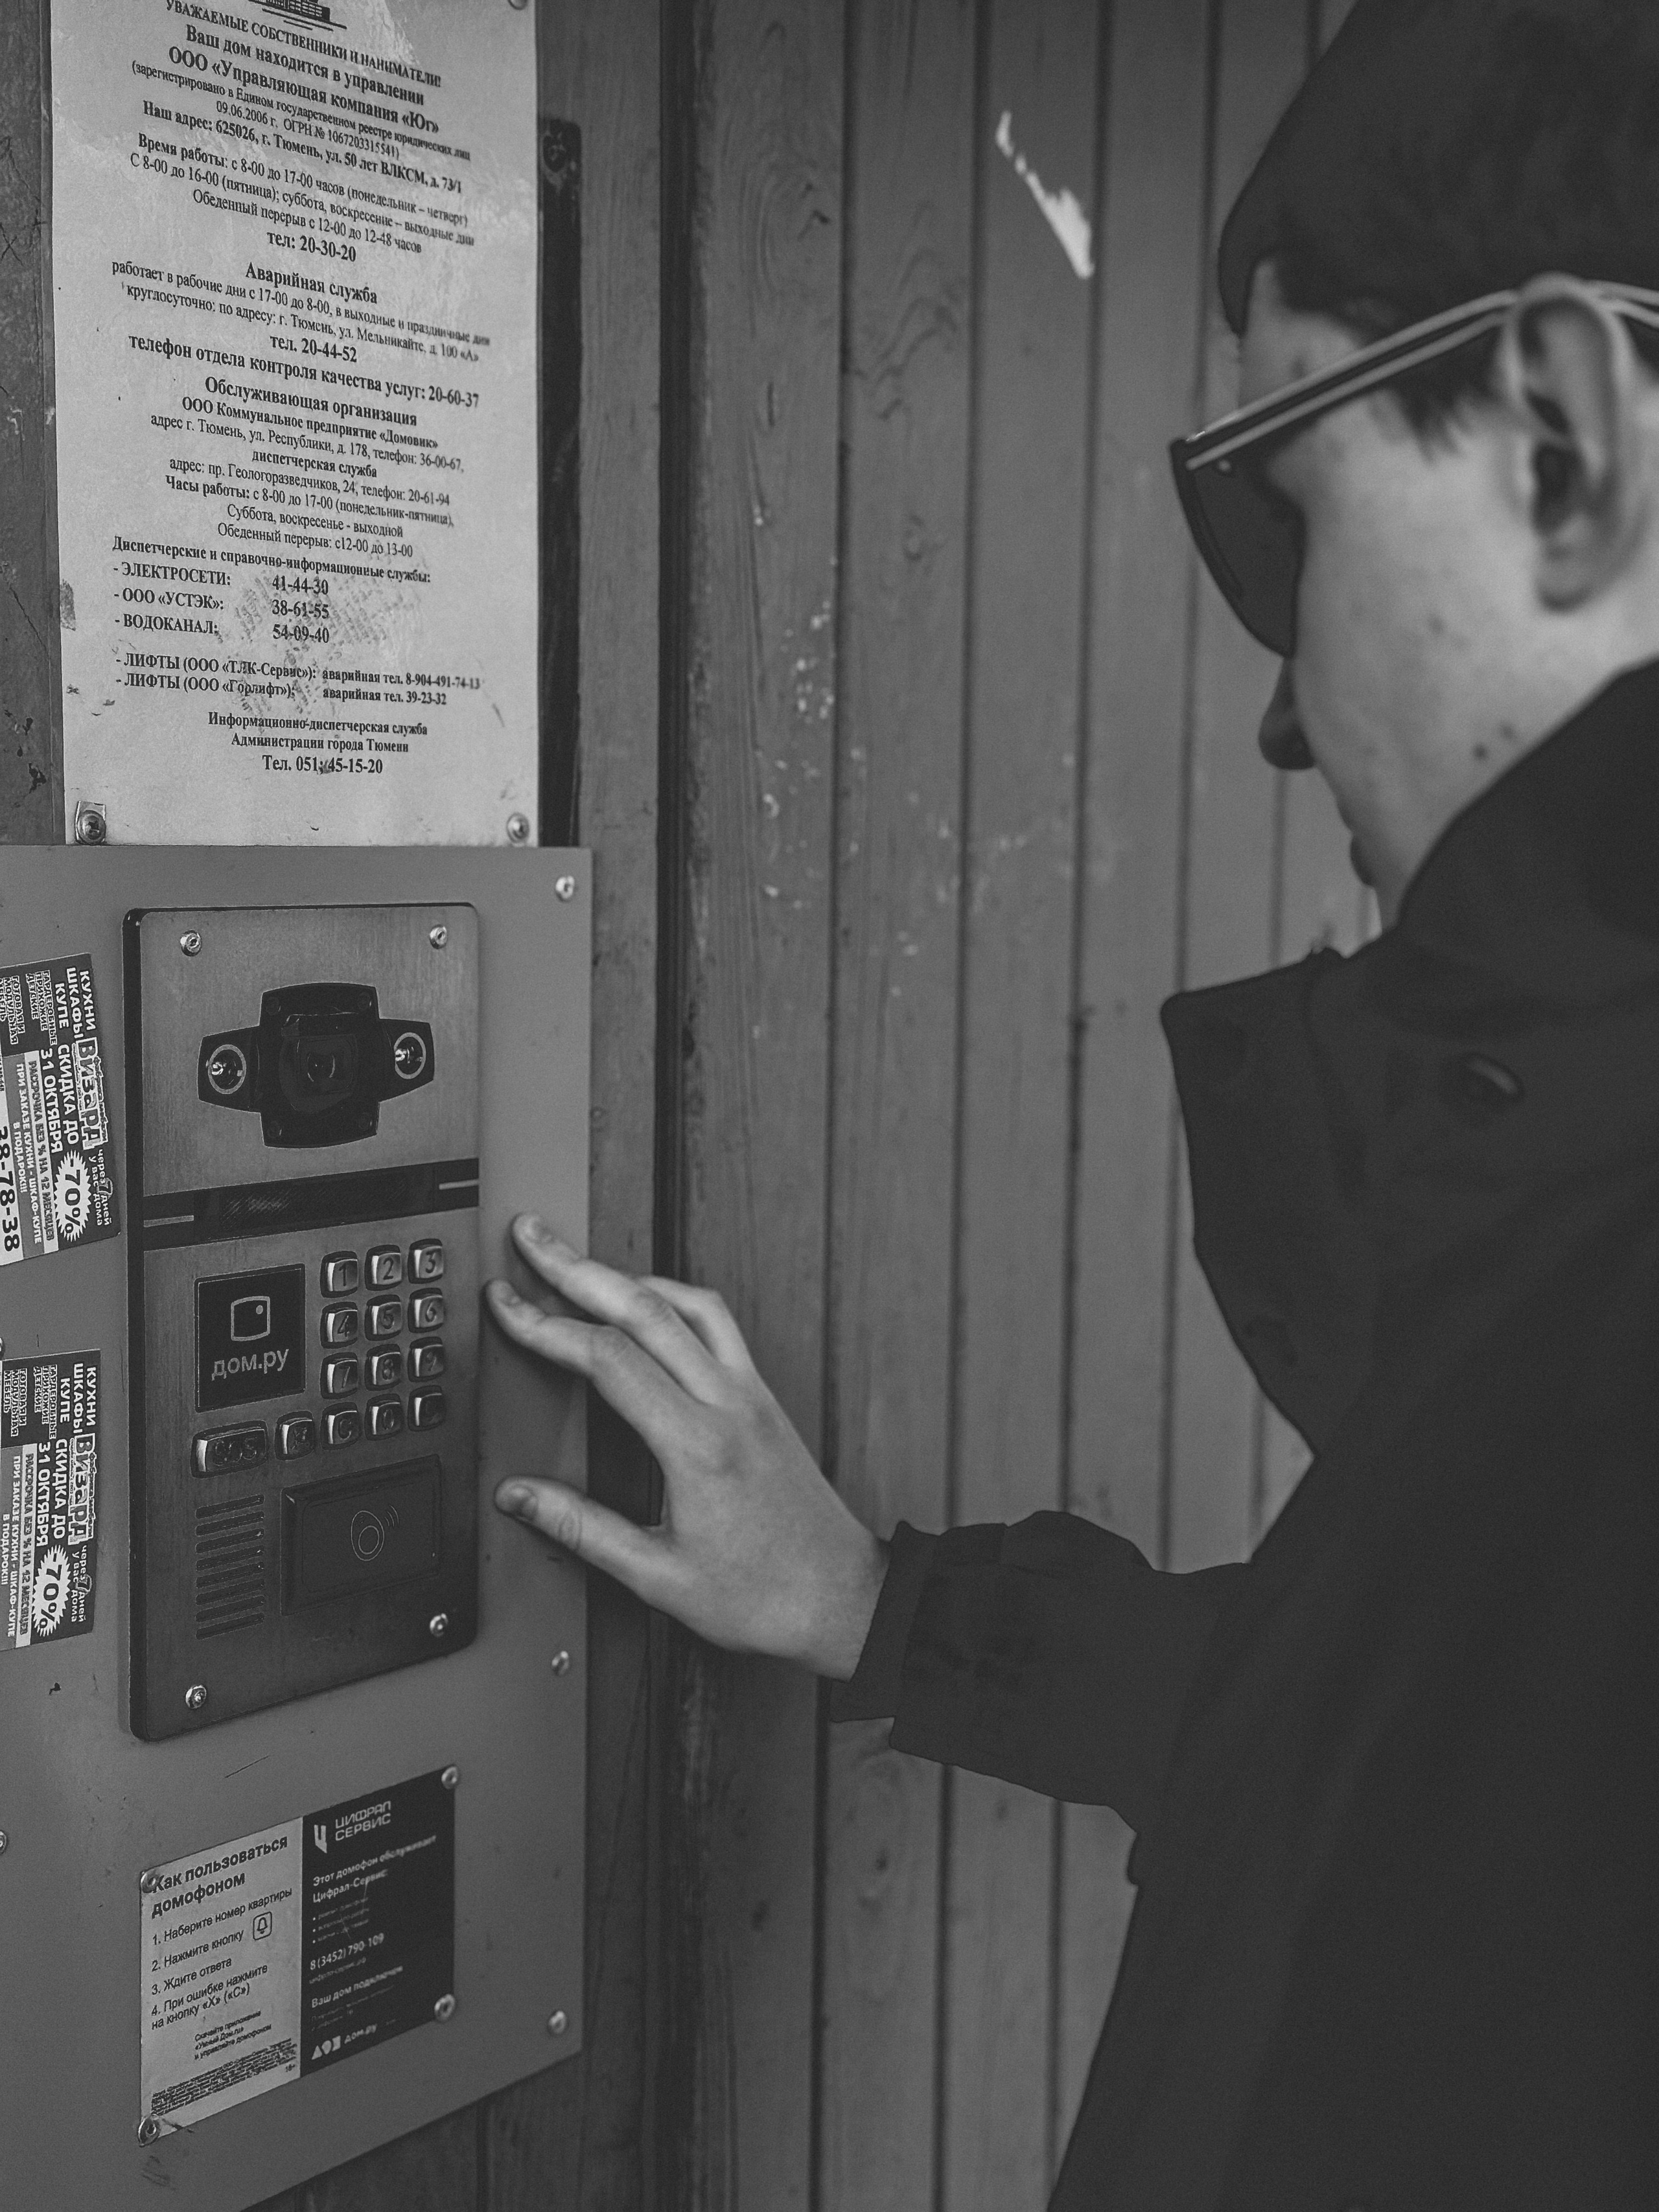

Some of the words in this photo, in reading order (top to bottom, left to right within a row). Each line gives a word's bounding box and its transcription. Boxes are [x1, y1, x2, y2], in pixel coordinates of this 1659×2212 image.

[166, 0, 249, 33] УВАЖАЕМЫЕ
[251, 21, 347, 61] СОБСТВЕННИКИ
[185, 23, 220, 49] Ваш
[223, 39, 251, 58] дом
[255, 46, 329, 80] находится
[343, 72, 424, 106] управлении
[168, 45, 209, 72] ООО
[211, 59, 327, 104] «Управляющая
[331, 93, 399, 124] компания
[401, 110, 439, 134] «Юг»
[143, 99, 172, 121] Наш
[174, 111, 213, 132] адрес:
[215, 119, 259, 145] 625026,
[272, 133, 323, 161] Тюмень,
[343, 152, 358, 168] 50
[358, 158, 378, 173] лет
[380, 159, 428, 187] ВЛКСМ,
[216, 100, 268, 125] 09.06.2006
[283, 118, 312, 137] ОГРН
[328, 129, 399, 161] 1067203315541)
[138, 132, 178, 156] Время
[180, 146, 228, 169] работы:
[240, 157, 265, 177] 8-00
[284, 169, 313, 189] 17-00
[315, 180, 345, 196] часов
[347, 185, 417, 214] (понедельник
[192, 189, 259, 216] Обеденный
[261, 206, 307, 228] перерыв
[319, 217, 346, 237] 12-00
[364, 227, 392, 247] 12-48
[393, 238, 423, 254] часов
[266, 231, 296, 250] тел:
[299, 235, 356, 262] 20-30-20
[245, 261, 325, 294] Аварийная
[329, 282, 378, 305] служба
[128, 335, 192, 359] телефон
[196, 348, 246, 368] отдела
[249, 357, 318, 381] контроля
[321, 369, 382, 392] качества
[385, 381, 426, 401] услуг:
[428, 385, 480, 408] 20-60-37
[269, 335, 297, 353] тел.
[301, 337, 358, 364] 20-44-52
[181, 396, 214, 414] ООО
[216, 401, 303, 429] Коммунальное
[306, 419, 377, 440] предприятие
[379, 428, 439, 449] «Домовик»
[205, 376, 329, 412] Обслуживающая
[332, 402, 417, 427] организация
[251, 450, 336, 472] диспетчерская
[338, 463, 377, 479] служба
[111, 535, 207, 560] Диспетчерские
[220, 551, 385, 584] справочно-информационные
[386, 569, 431, 583] службы:
[121, 561, 231, 586] ЭЛЕКТРОСЕТИ:
[272, 575, 329, 598] 41-44-30
[122, 587, 156, 604] ООО
[157, 591, 224, 611] «УСТЭК»:
[272, 599, 330, 622] 38-61-55
[272, 623, 330, 646] 54-09-40
[123, 652, 180, 669] ЛИФТЫ
[183, 657, 220, 673] (ООО
[222, 656, 318, 682] «ТЛК-Сервис»):
[322, 666, 380, 684] аварийная
[382, 674, 404, 685] тел.
[124, 672, 180, 690] ЛИФТЫ
[183, 676, 220, 692] (ООО
[323, 686, 381, 703] аварийная
[383, 692, 404, 703] тел.
[406, 692, 447, 706] 39-23-32
[231, 731, 324, 751] Администрации
[327, 736, 364, 754] города
[365, 738, 409, 753] Тюмени
[392, 723, 428, 738] служба
[262, 754, 292, 771] Тел.
[327, 756, 383, 774] 45-15-20
[3, 977, 18, 1044] МОДУЛЬНАЯ
[25, 973, 39, 1019] ДЕТСКИЕ
[34, 972, 48, 1030] ПРИХОЖИЕ
[41, 970, 57, 1046] ГАРДЕРОБНЫЕ
[54, 983, 69, 1028] КУПЕ
[66, 967, 84, 1038] ШКАФЫ
[79, 970, 96, 1030] КУХНИ
[40, 1048, 54, 1069] 31
[54, 1044, 76, 1114] СКИДКА
[19, 1089, 30, 1129] ЗАКАЗЕ
[43, 1075, 63, 1153] ОКТЯБРЯ
[71, 1037, 107, 1149] Визард
[23, 1132, 34, 1168] КУХНИ
[62, 1120, 79, 1144] ДО
[12, 1132, 27, 1193] ПОДАРОК!!!
[28, 1178, 41, 1244] ШКАФ-КУПЕ
[58, 1158, 86, 1233] -70%
[382, 1257, 394, 1280] 2
[425, 1251, 436, 1274] 3
[212, 1349, 289, 1381] дом.ру
[49, 1364, 58, 1439] ГАРДЕРОБНЫЕ
[60, 1378, 70, 1423] КУПЕ
[73, 1363, 84, 1433] ШКАФЫ
[86, 1367, 97, 1425] КУХНИ
[38, 1441, 50, 1463] 31
[51, 1439, 67, 1509] СКИДКА
[12, 1480, 20, 1521] ЗАКАЗЕ
[36, 1469, 49, 1546] ОКТЯБРЯ
[67, 1433, 95, 1544] Визард
[10, 1524, 19, 1561] КУХНИ
[51, 1515, 65, 1539] ДО
[0, 1523, 9, 1585] ПОДАРОК!!!
[8, 1570, 17, 1636] ШКАФ-КУПЕ
[39, 1553, 62, 1628] -70%
[335, 1800, 391, 1829] ЦИФРАЛ
[335, 1813, 391, 1841] СЕРВИС
[152, 1872, 182, 1893] Как
[185, 1835, 287, 1882] пользоваться
[313, 1872, 334, 1886] Этот
[336, 1857, 378, 1880] домофон
[152, 1872, 245, 1919] домофоном
[152, 1934, 161, 1946] 1.
[163, 1916, 213, 1942] Наберите
[215, 1905, 246, 1923] номер
[248, 1887, 292, 1911] квартиры
[152, 1959, 161, 1972] 2.
[164, 1943, 209, 1968] Нажмите
[211, 1929, 244, 1950] кнопку
[151, 2004, 161, 2016] 4.
[163, 1996, 184, 2012] При
[186, 1981, 224, 2003] ошибке
[226, 1964, 268, 1988] нажмите
[152, 1983, 161, 1995] 3.
[163, 1971, 197, 1992] Ждите
[199, 1957, 232, 1977] ответа
[312, 1994, 331, 2008] Ваш
[332, 1986, 352, 2001] дом
[152, 2018, 164, 2030] на
[166, 2004, 200, 2025] кнопку
